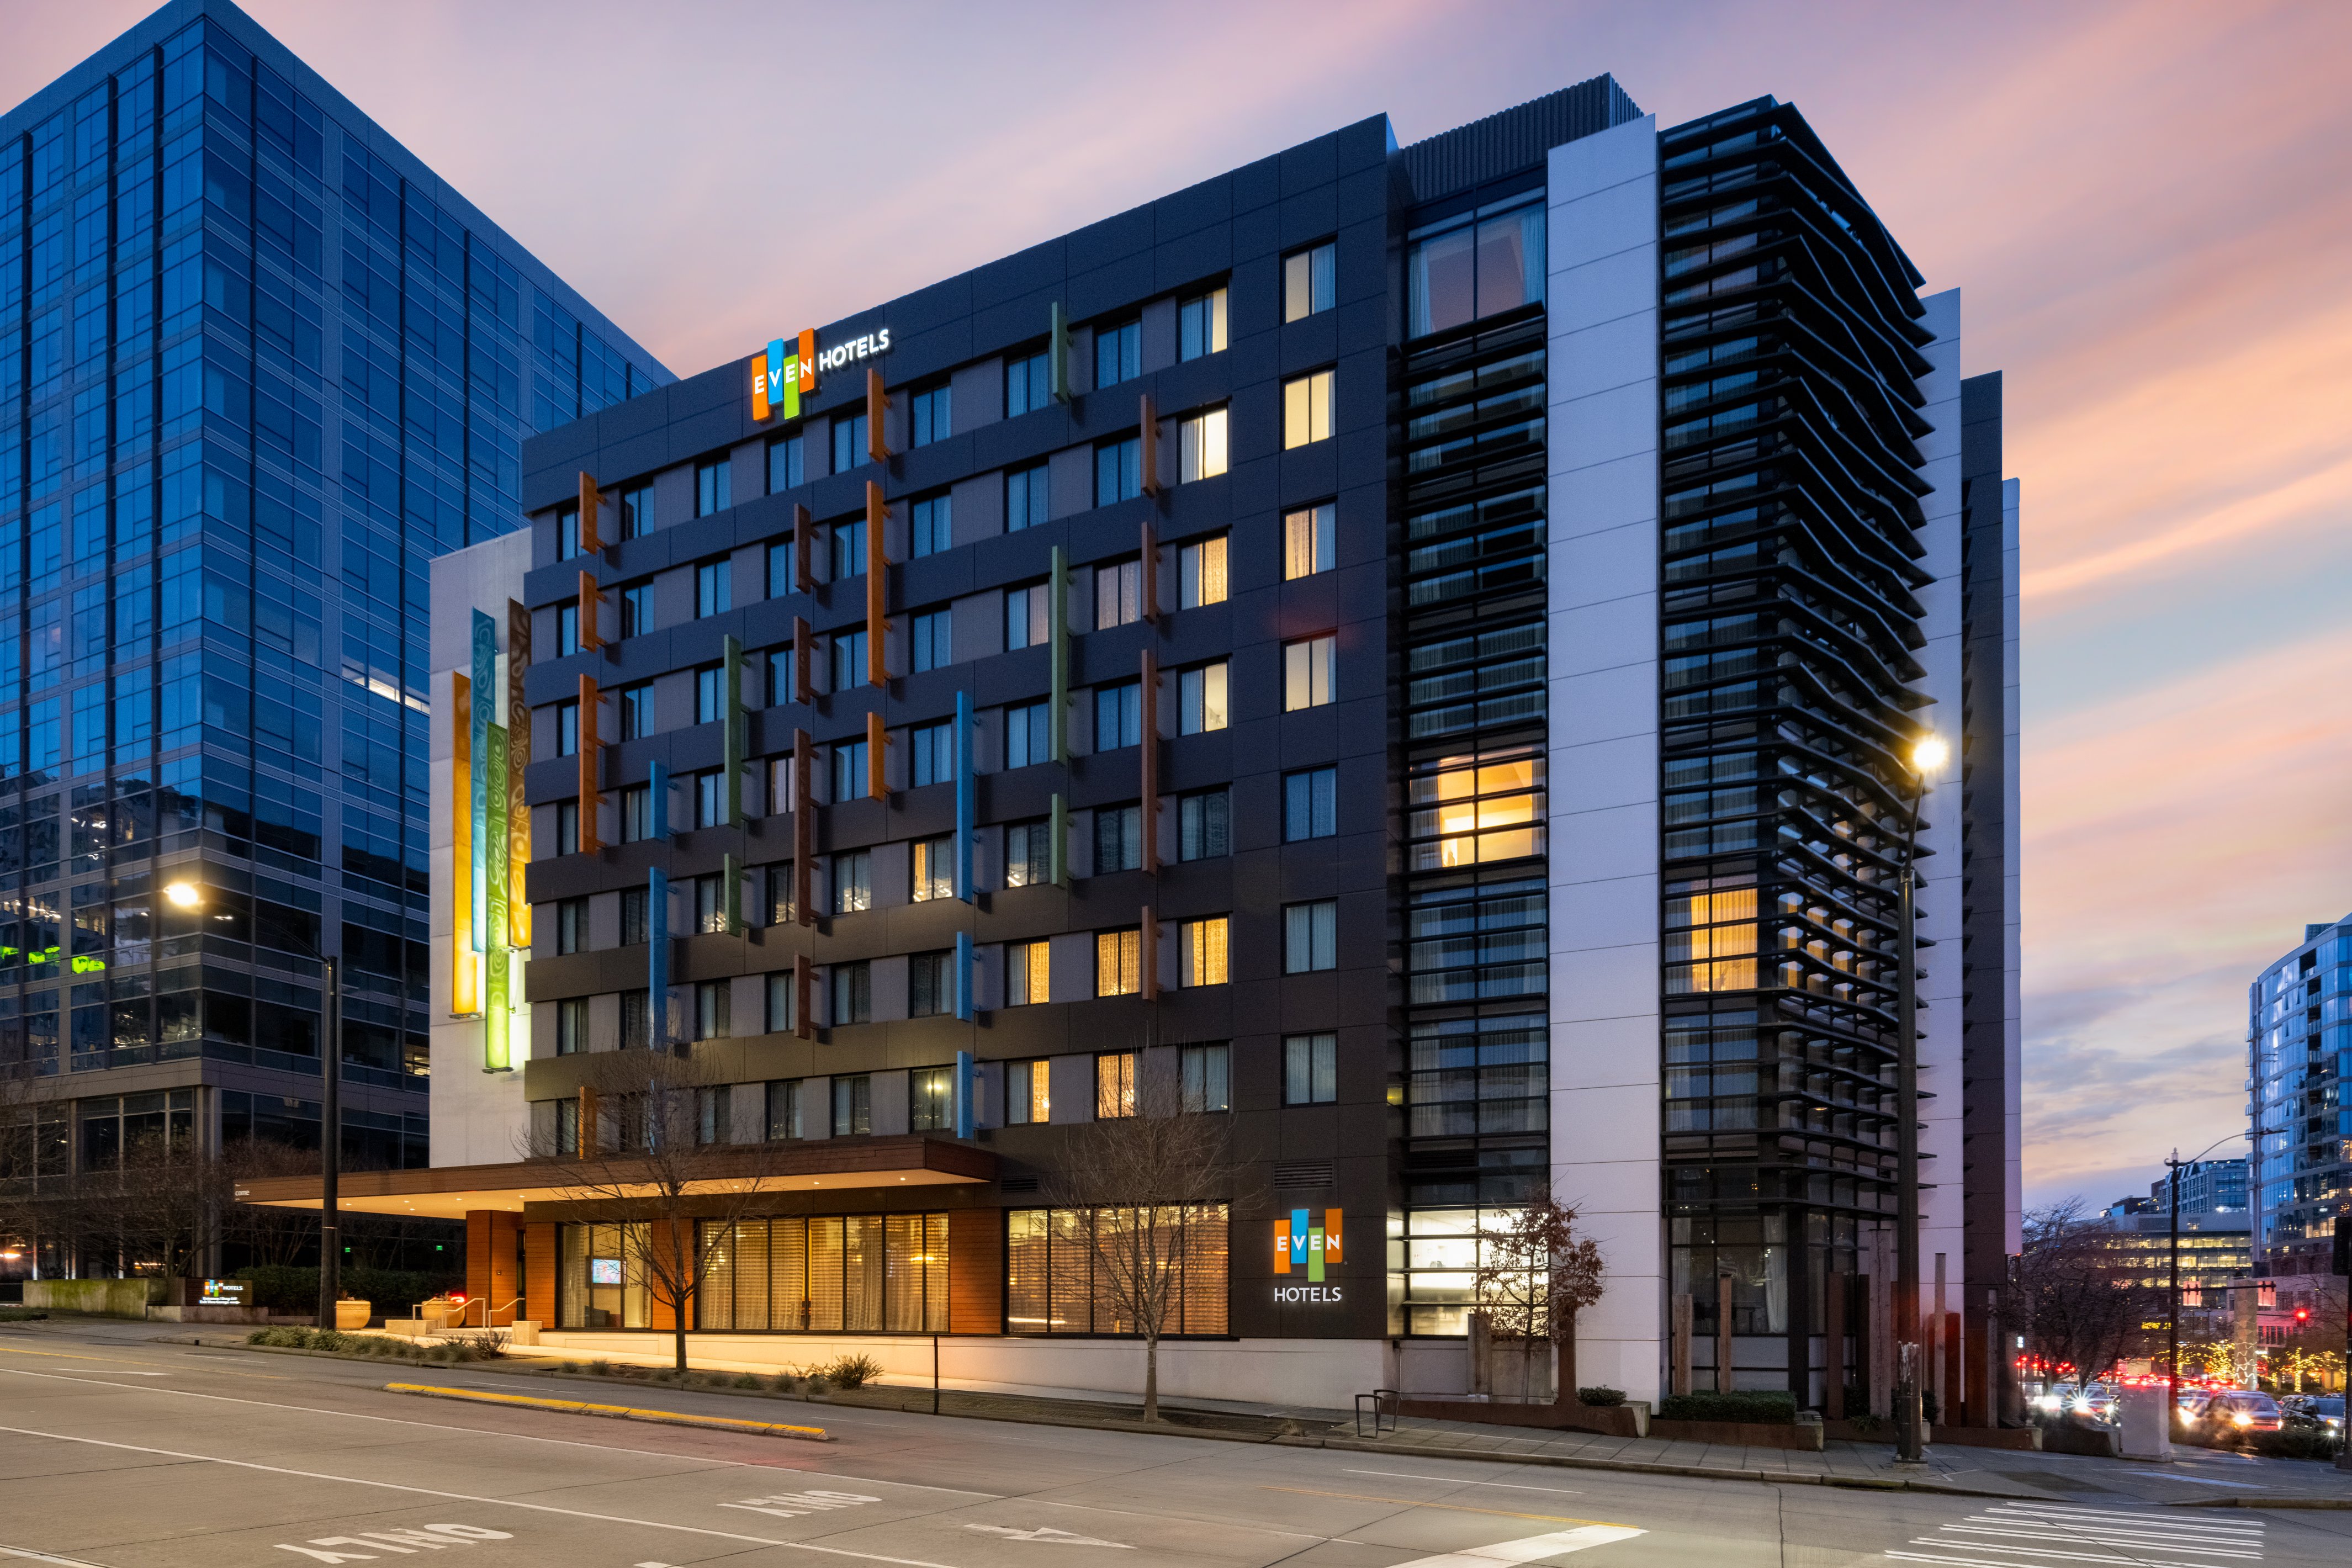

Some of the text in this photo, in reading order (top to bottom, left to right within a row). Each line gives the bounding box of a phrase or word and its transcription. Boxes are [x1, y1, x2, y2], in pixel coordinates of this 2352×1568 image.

[754, 329, 889, 394] EVEN HOTELS
[1277, 1235, 1339, 1251] EVEN
[1274, 1287, 1342, 1302] HOTELS
[716, 1490, 883, 1517] ONLY
[273, 1523, 514, 1564] ONLY
